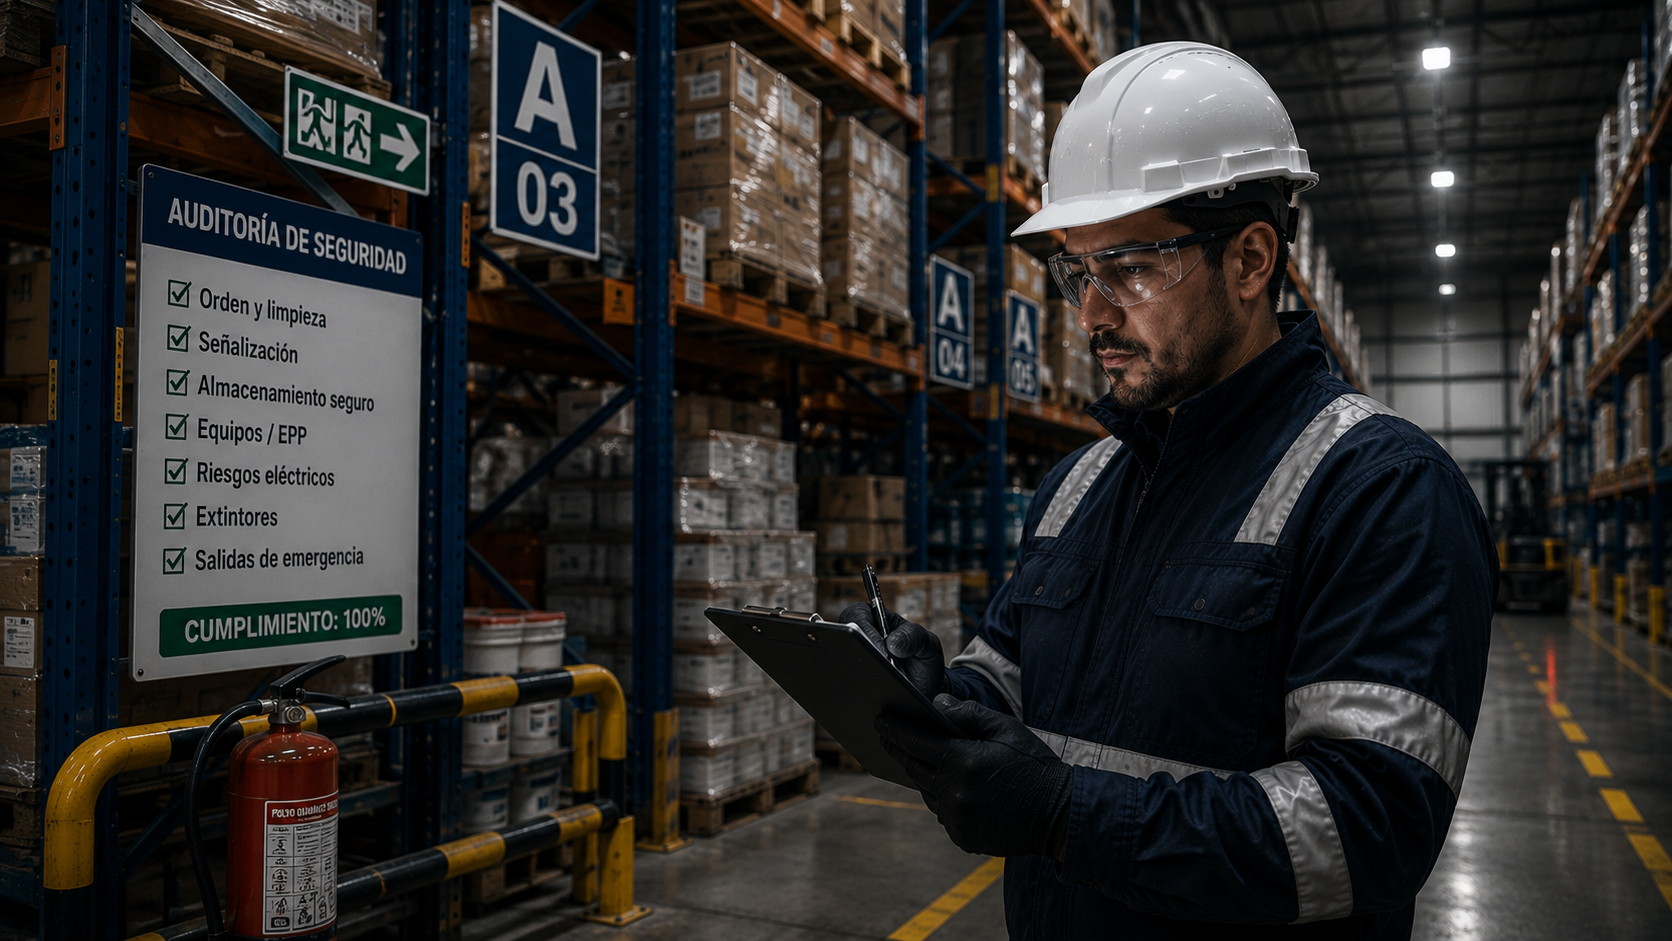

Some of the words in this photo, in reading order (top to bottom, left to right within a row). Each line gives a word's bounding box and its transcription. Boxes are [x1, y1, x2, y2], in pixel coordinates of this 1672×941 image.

[514, 40, 578, 151] A
[516, 160, 578, 237] 03
[167, 197, 281, 248] AUDITORÍA
[285, 224, 310, 254] DE
[313, 231, 407, 275] SEGURIDAD
[199, 287, 249, 315] Orden
[253, 302, 263, 322] y
[267, 299, 327, 329] limpieza
[937, 272, 965, 333] A
[198, 331, 298, 364] Señalización
[1010, 303, 1034, 354] A
[937, 338, 966, 379] 04
[197, 374, 327, 407] Almacenamiento
[329, 393, 375, 415] seguro
[197, 418, 263, 446] Equipos
[266, 423, 275, 446] /
[278, 424, 307, 446] EPP
[196, 461, 261, 489] Riesgos
[265, 464, 335, 487] eléctricos
[196, 505, 278, 527] Extintores
[195, 548, 255, 571] Salidas
[259, 548, 279, 568] de
[283, 546, 364, 571] emergencia
[184, 609, 339, 643] CUMPLIMIENTO:
[343, 606, 386, 629] 100%
